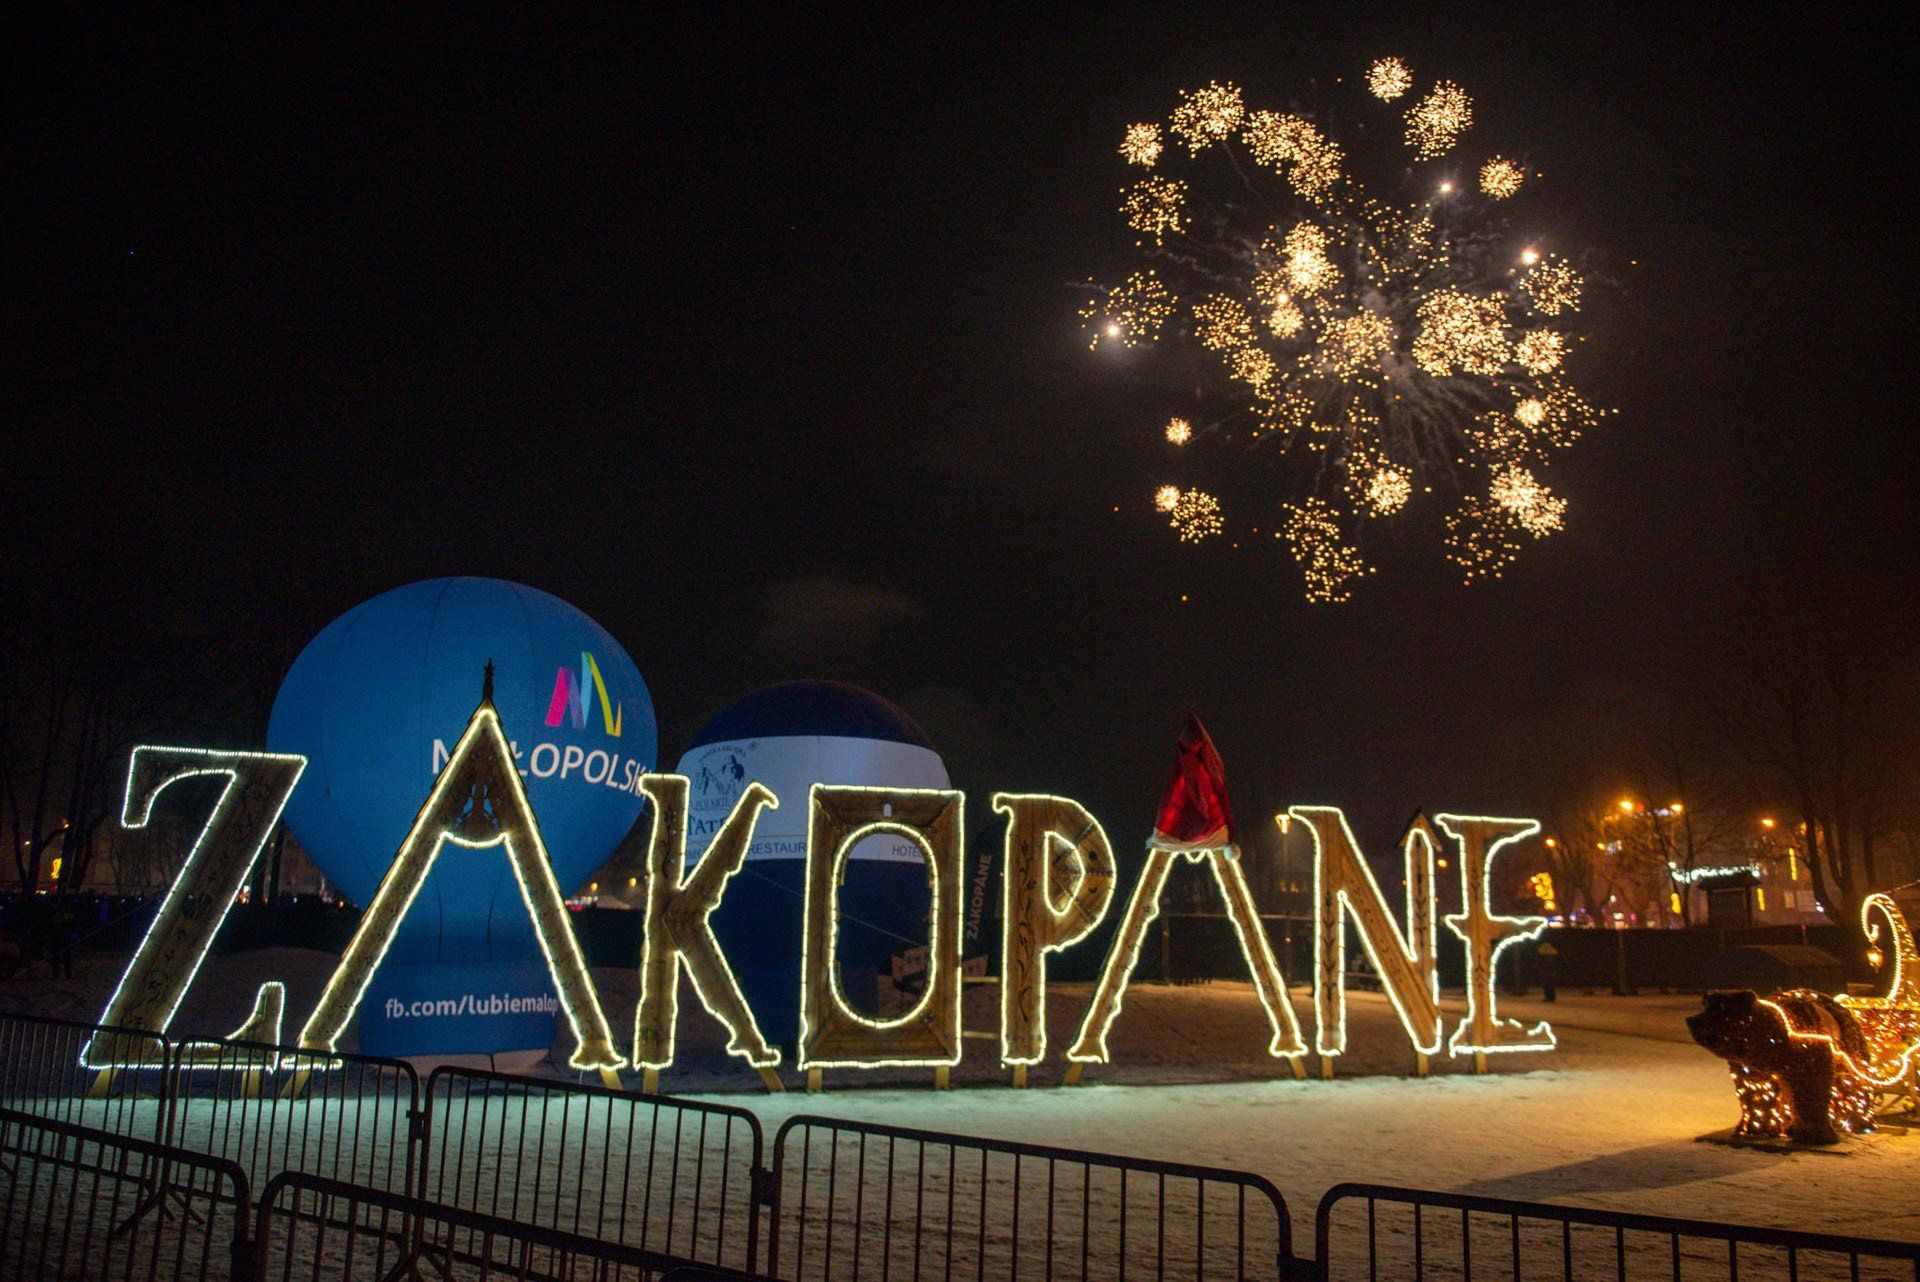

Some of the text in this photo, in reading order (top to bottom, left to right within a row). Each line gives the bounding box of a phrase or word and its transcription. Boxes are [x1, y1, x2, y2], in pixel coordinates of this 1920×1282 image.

[431, 738, 652, 801] MŁOPOLSK
[79, 706, 1557, 1075] ZAKOPANE
[966, 853, 993, 941] ZAKOPANE
